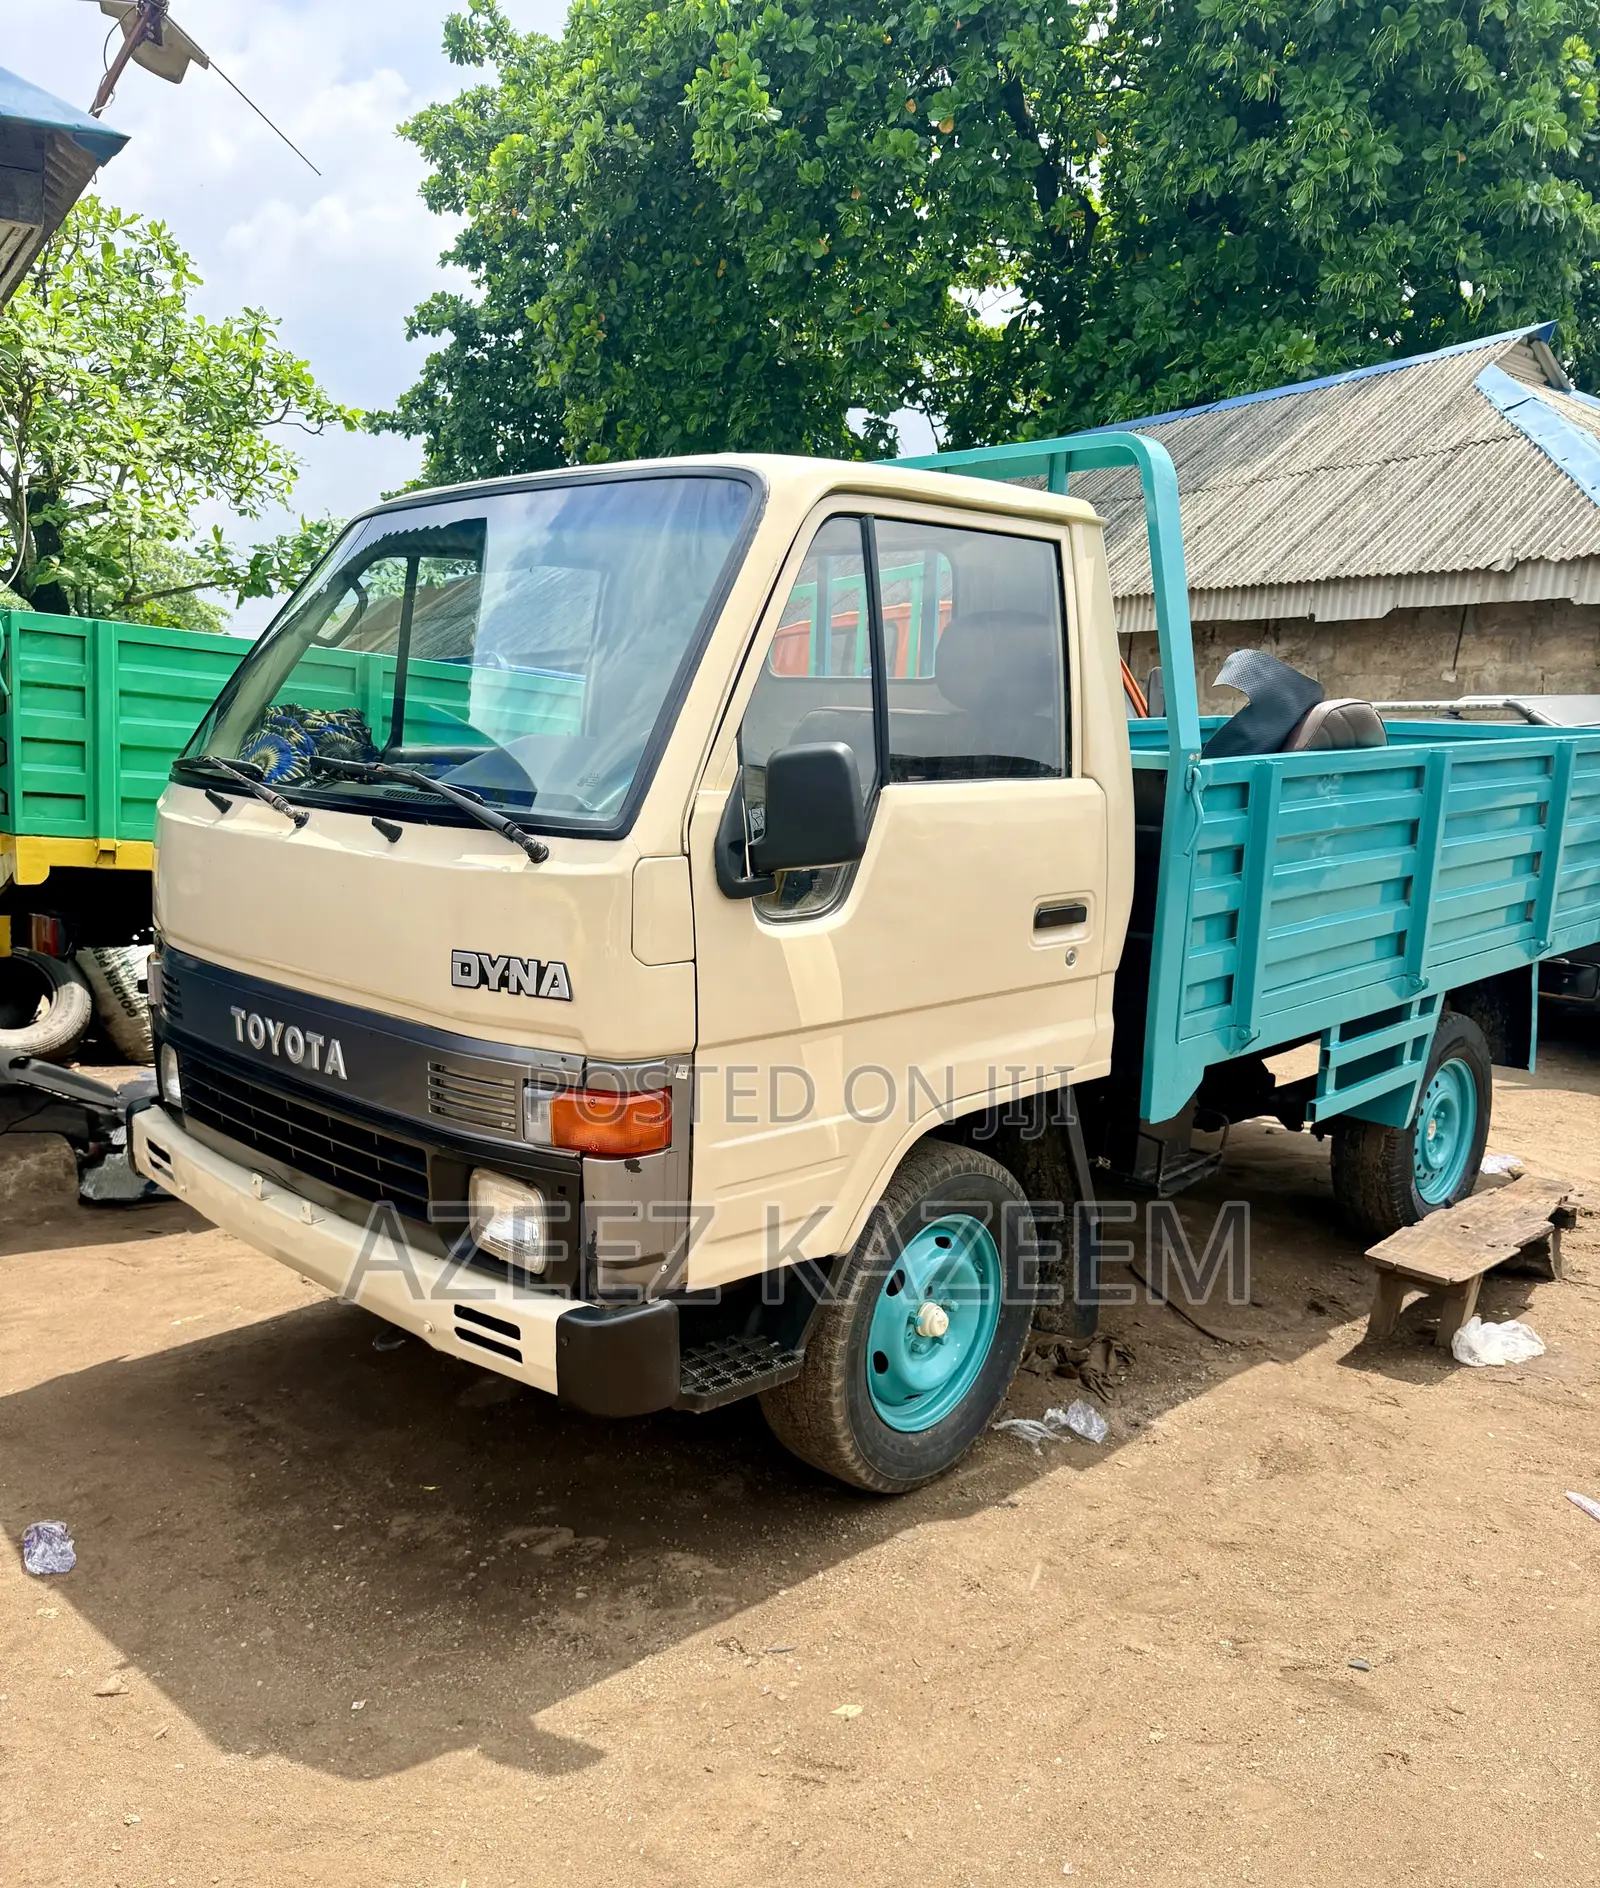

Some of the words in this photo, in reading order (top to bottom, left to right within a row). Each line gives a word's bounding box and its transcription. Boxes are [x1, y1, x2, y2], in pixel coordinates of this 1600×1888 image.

[103, 970, 138, 1018] GOLDEN
[451, 949, 573, 1002] DYNA
[230, 1005, 348, 1080] TOYOTA
